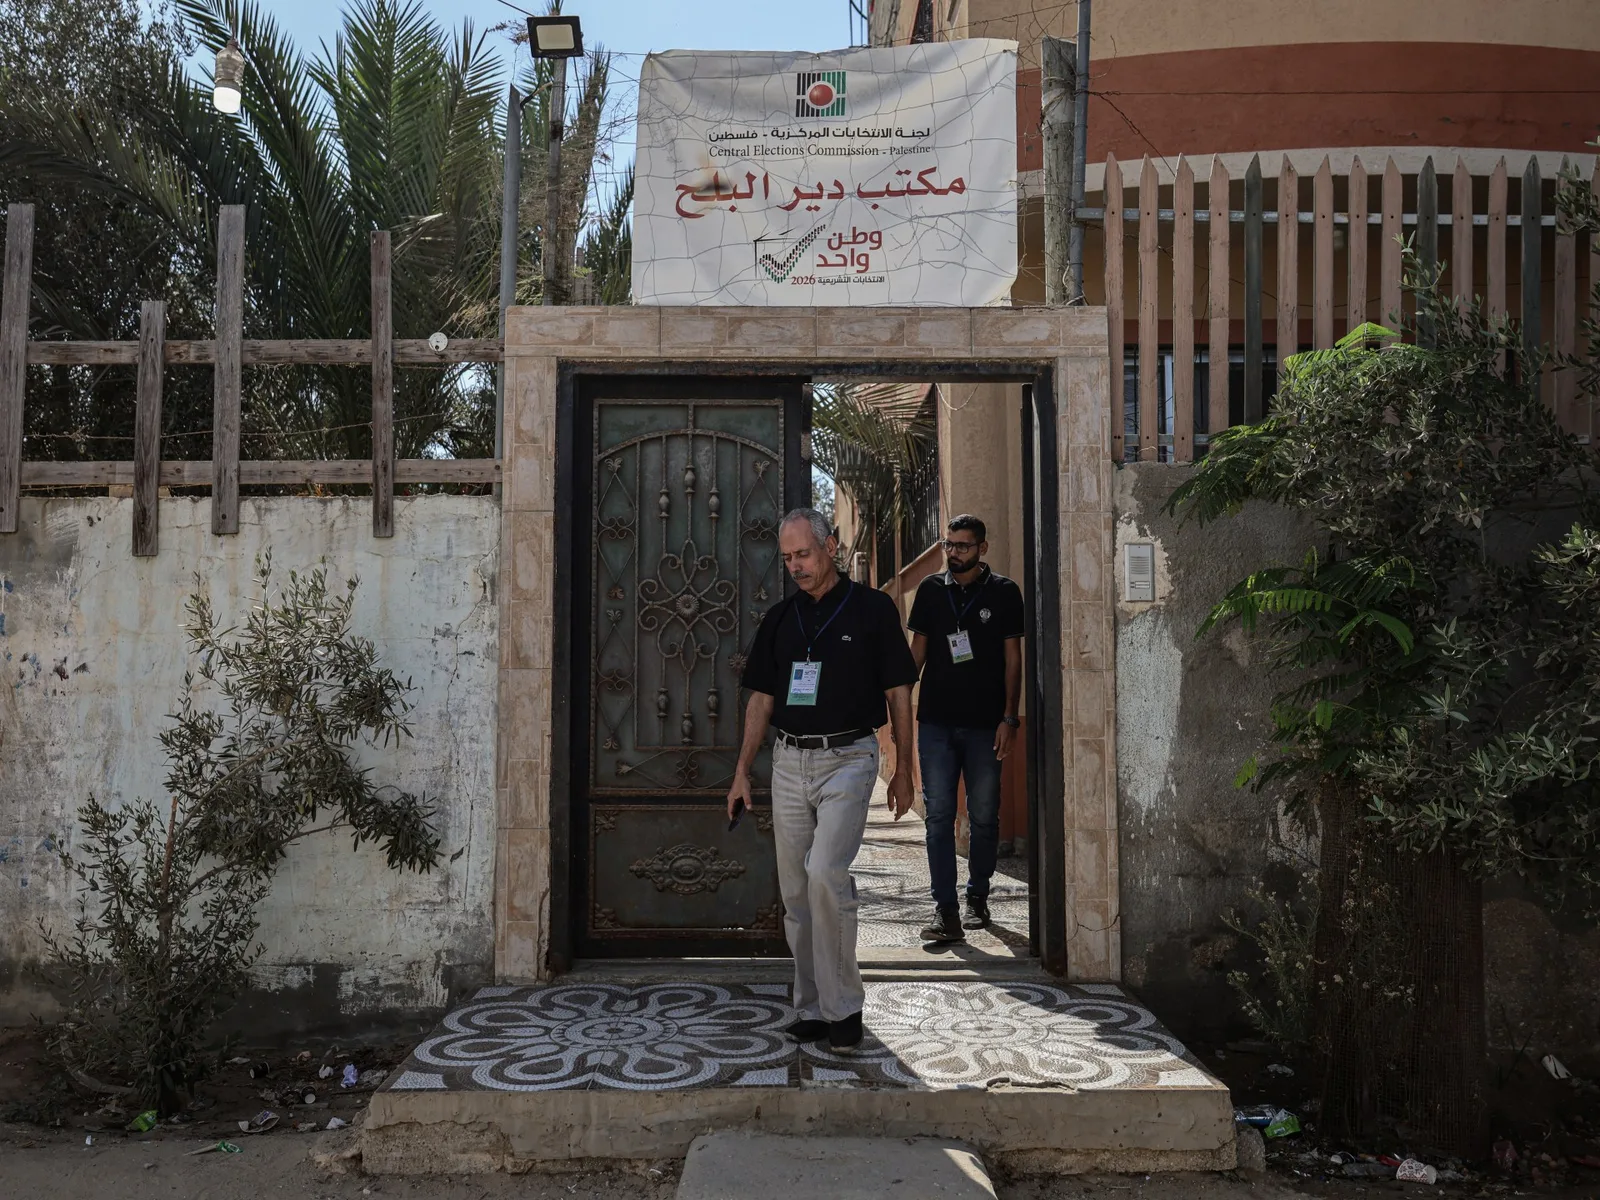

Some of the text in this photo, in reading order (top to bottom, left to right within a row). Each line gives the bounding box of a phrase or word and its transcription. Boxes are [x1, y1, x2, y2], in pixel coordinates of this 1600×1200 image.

[708, 130, 758, 142] فلسطين
[770, 127, 830, 141] المركزية
[832, 127, 892, 140] الانتخابات
[895, 127, 930, 140] لجنة
[709, 145, 750, 157] Central
[753, 144, 805, 156] Elections
[807, 143, 879, 156] Commission
[889, 146, 931, 155] Palestine
[675, 166, 967, 219] مكتب دير البلح
[827, 226, 883, 251] وطن
[816, 248, 870, 274] واحد
[791, 275, 886, 286] الانتخابات التشريعية 2026
